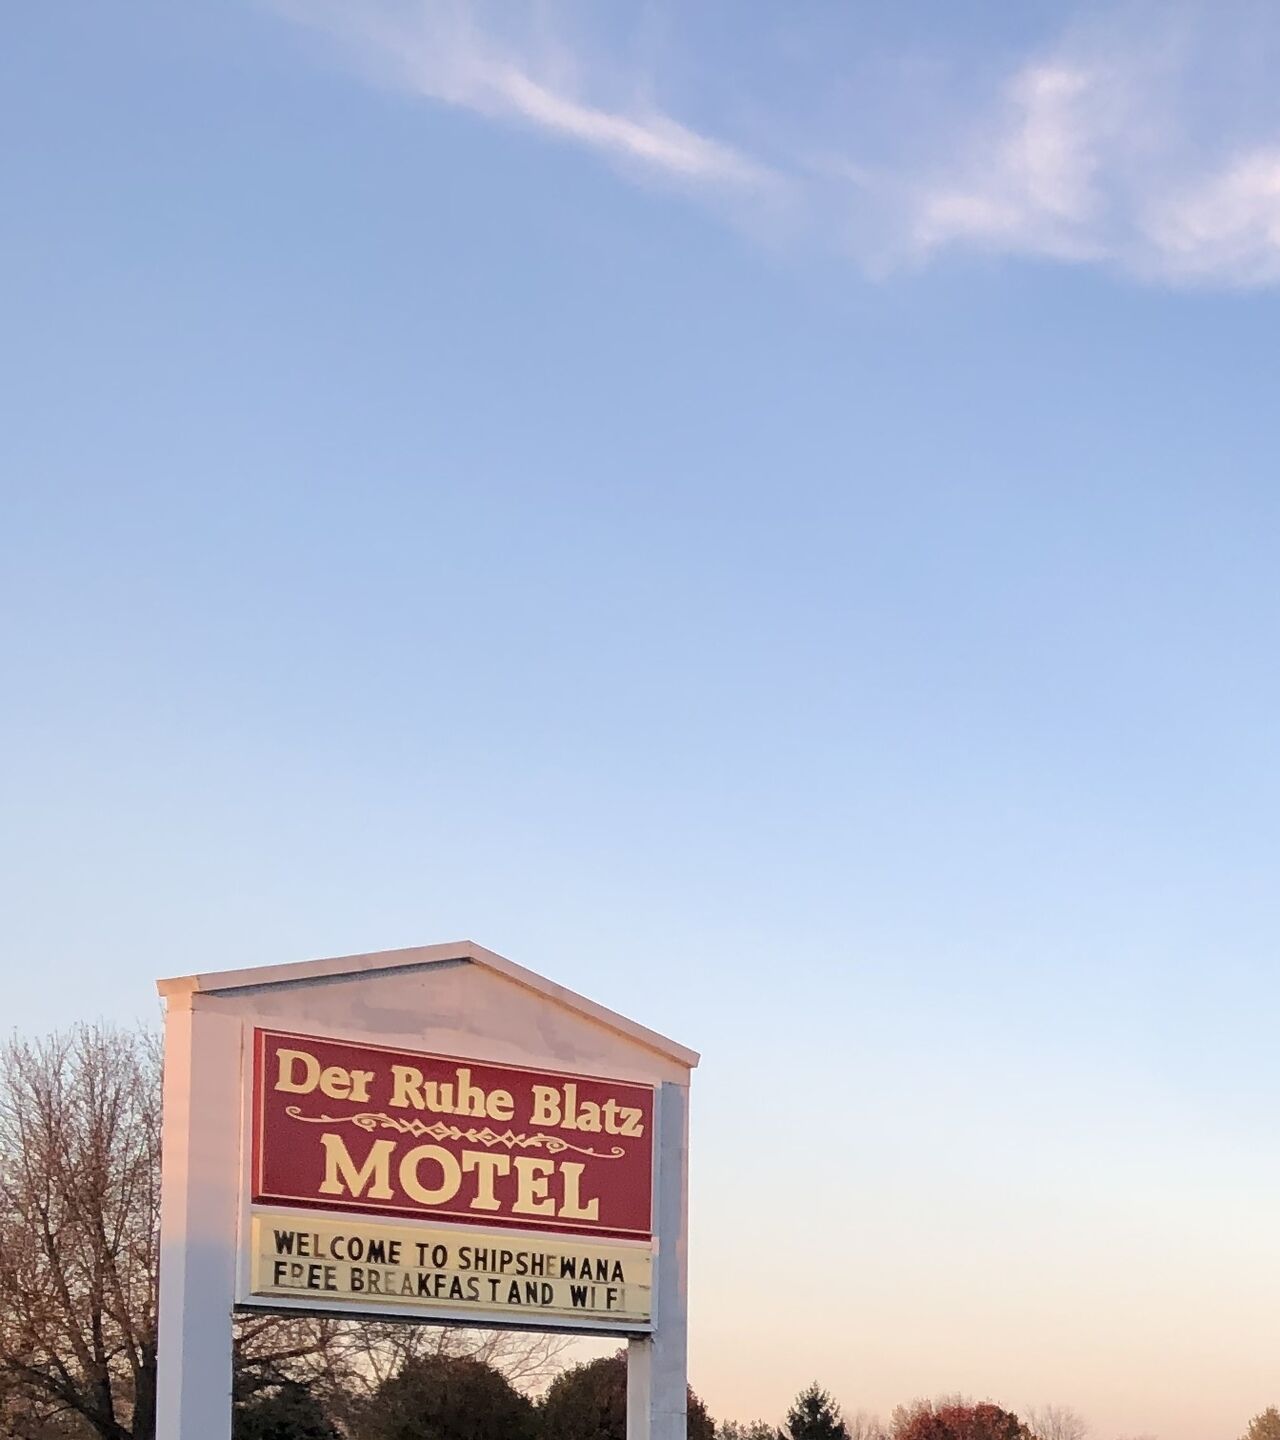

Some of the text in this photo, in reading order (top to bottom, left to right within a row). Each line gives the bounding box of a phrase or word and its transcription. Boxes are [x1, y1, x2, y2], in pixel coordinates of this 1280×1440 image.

[275, 1047, 644, 1138] Der Ruhe Blatz
[318, 1132, 599, 1221] MOTEL
[273, 1229, 625, 1283] WELCOME TO SHIPSHEWANA
[507, 1279, 554, 1305] AND
